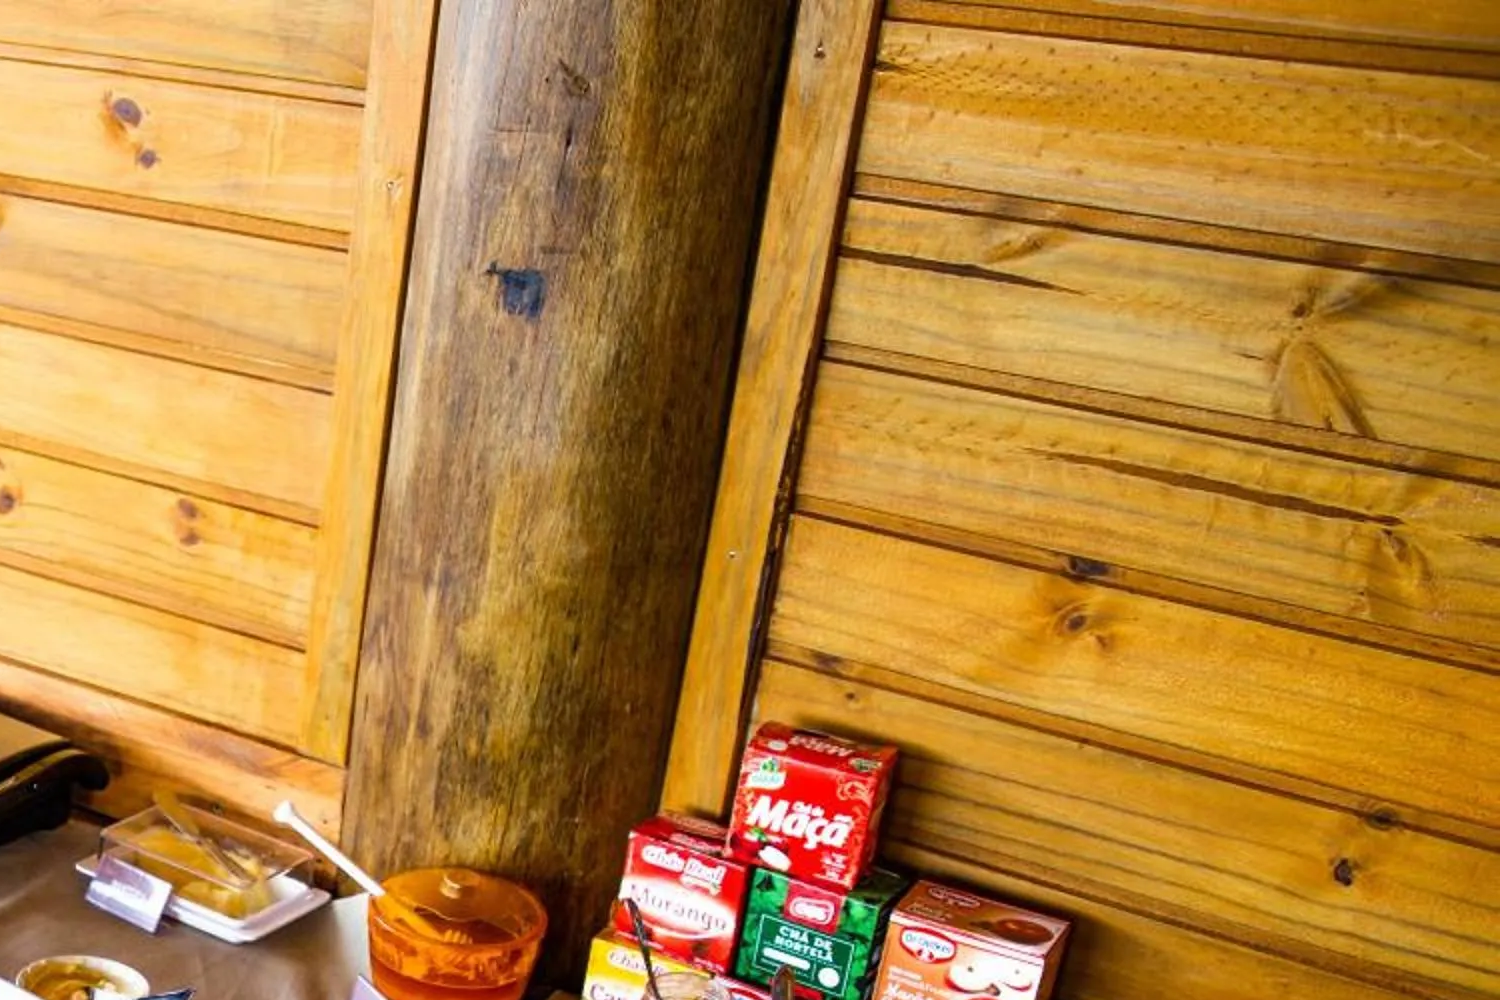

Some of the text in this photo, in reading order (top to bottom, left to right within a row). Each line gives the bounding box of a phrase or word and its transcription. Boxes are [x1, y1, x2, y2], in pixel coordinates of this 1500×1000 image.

[745, 795, 854, 850] Maçã
[630, 883, 728, 931] Morango
[814, 937, 833, 951] DE
